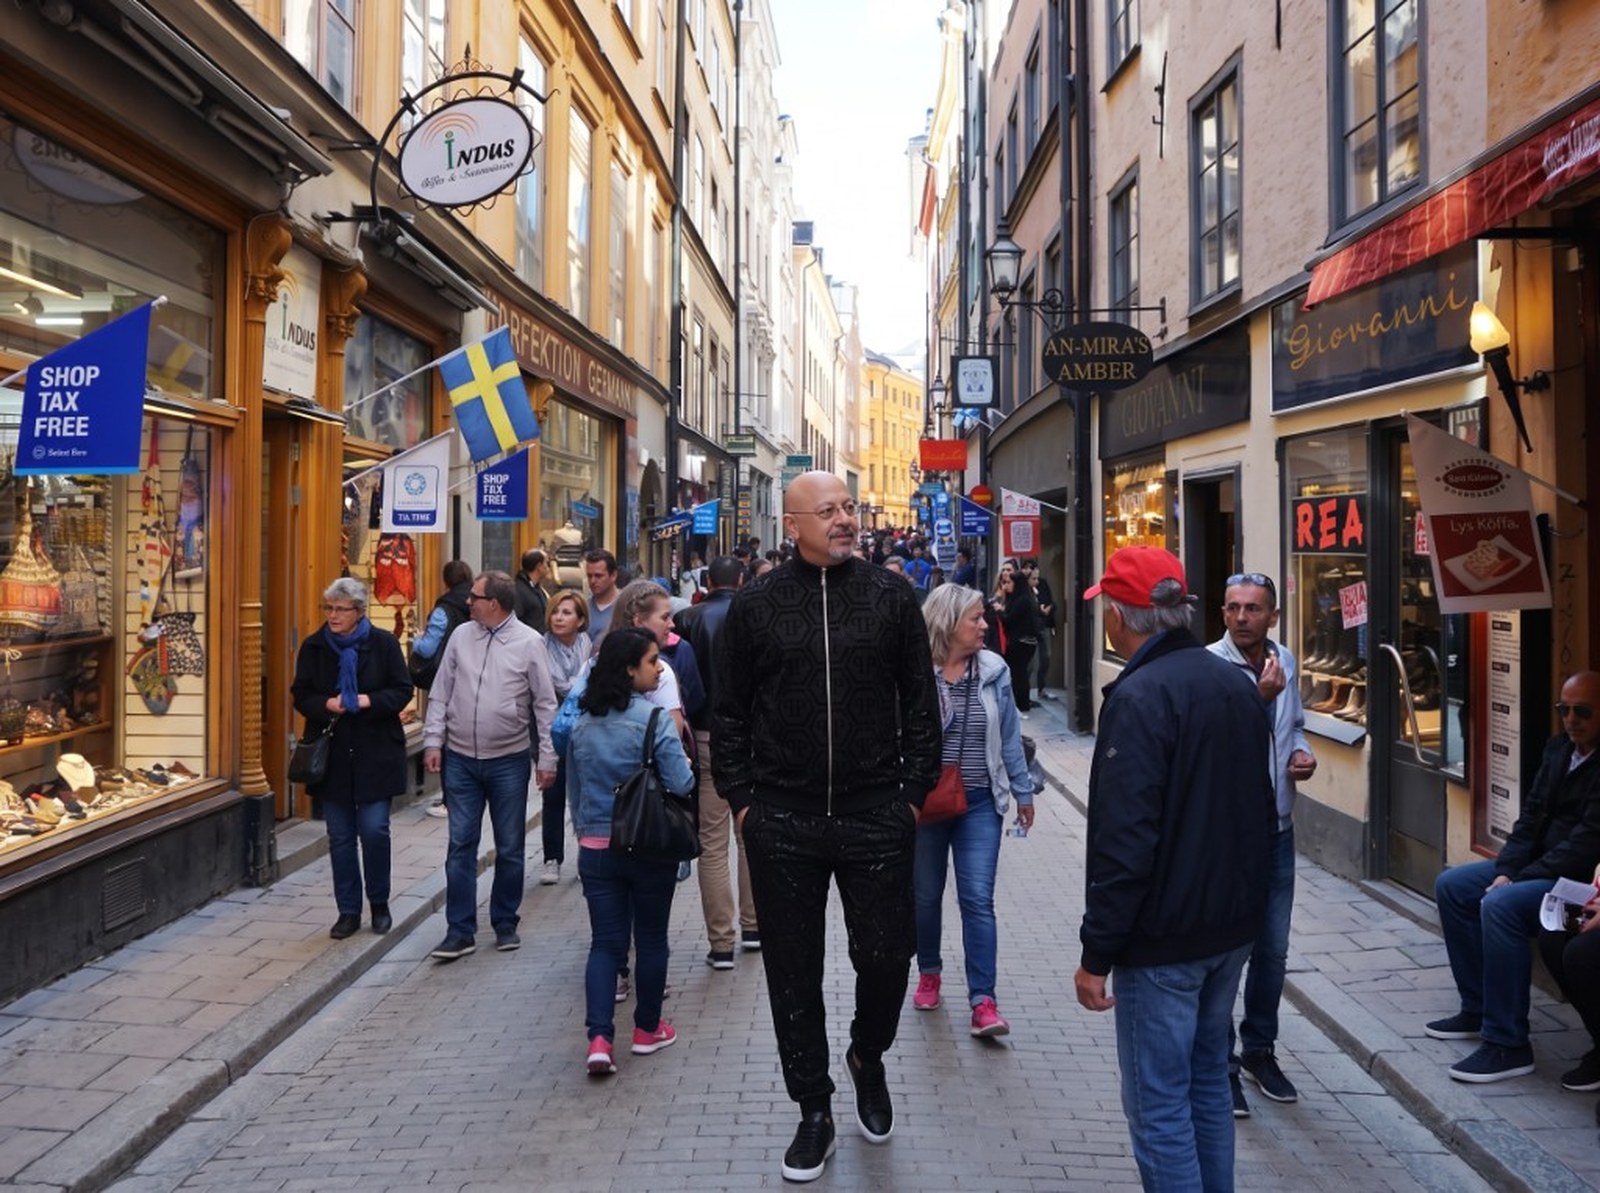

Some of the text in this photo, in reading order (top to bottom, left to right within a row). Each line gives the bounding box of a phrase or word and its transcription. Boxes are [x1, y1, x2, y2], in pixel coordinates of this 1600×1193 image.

[1288, 272, 1468, 370] Giovanni
[1045, 336, 1149, 356] AN-MIRA'S
[40, 365, 101, 388] SHOP
[1058, 362, 1136, 381] AMBER
[38, 391, 80, 413] TAX
[34, 416, 90, 438] FREE
[483, 473, 510, 485] SHOP
[483, 494, 508, 505] FREE
[1296, 498, 1364, 550] REA
